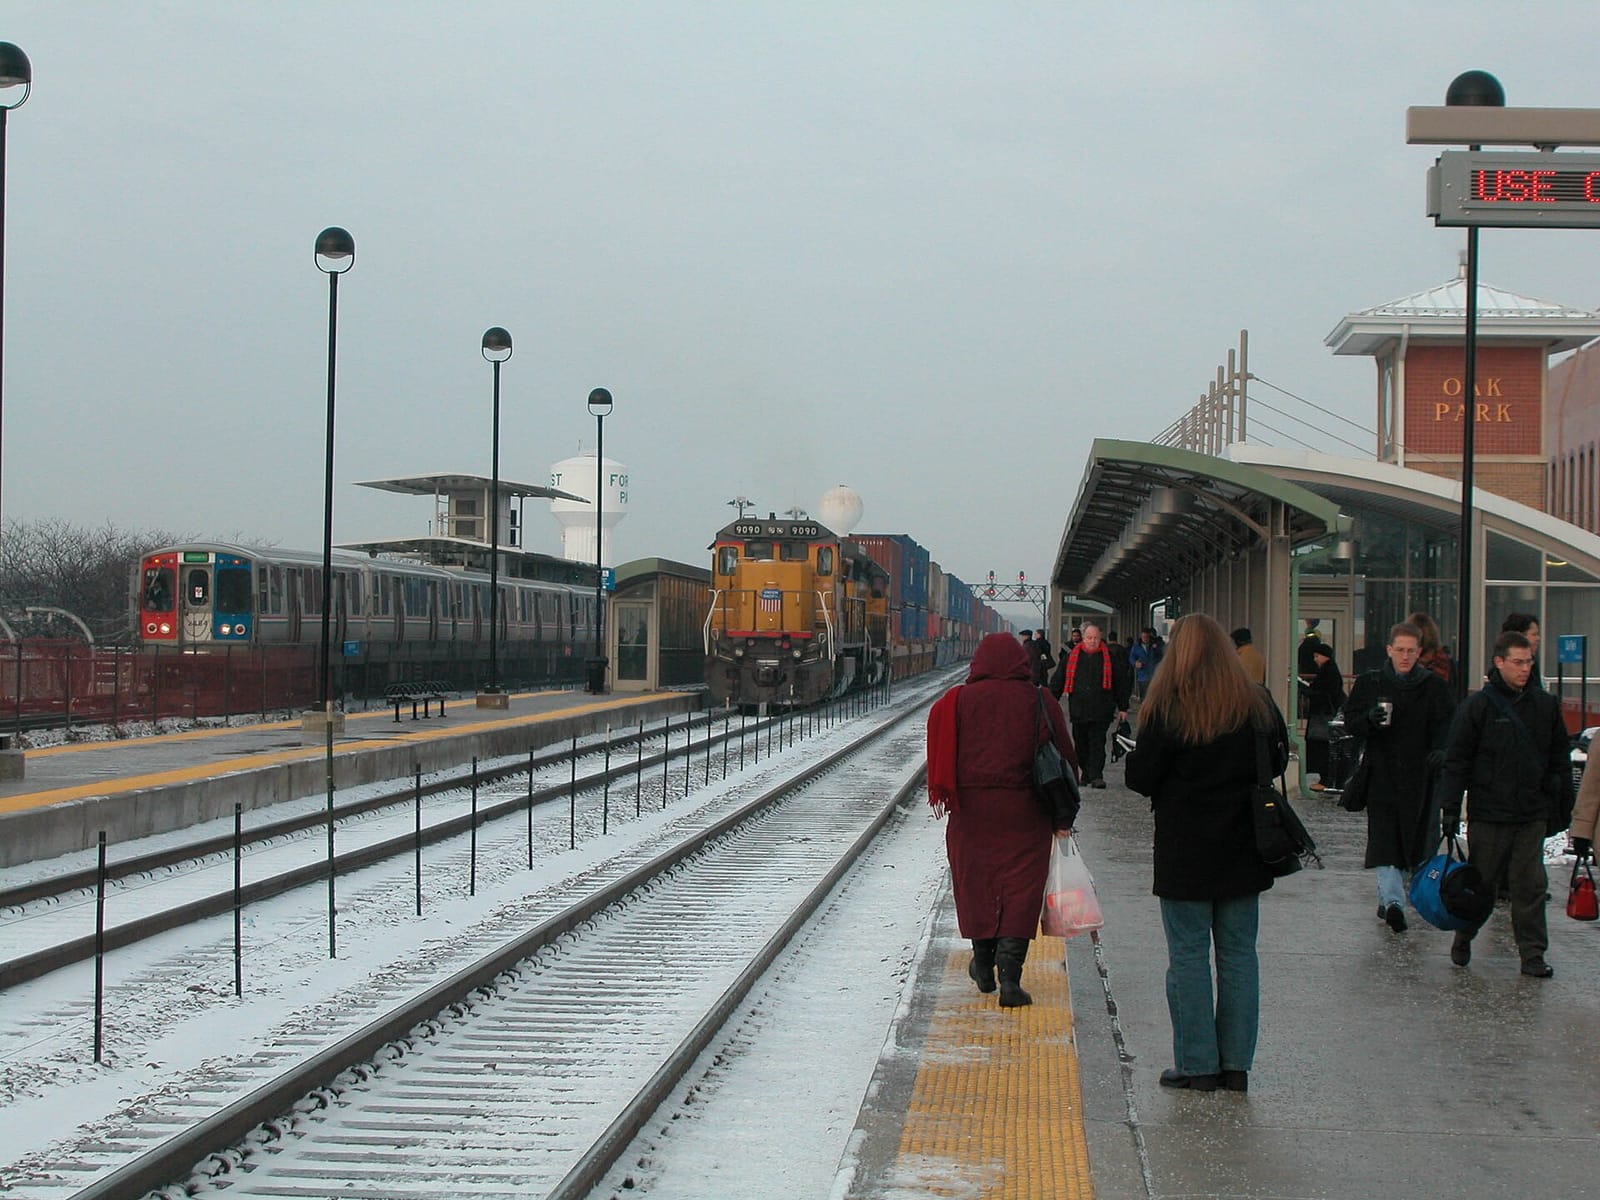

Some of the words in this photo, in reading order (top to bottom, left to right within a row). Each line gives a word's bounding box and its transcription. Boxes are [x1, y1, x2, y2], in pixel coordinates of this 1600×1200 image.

[1478, 170, 1556, 202] USE
[736, 525, 760, 534] 9090
[792, 526, 817, 535] 9090
